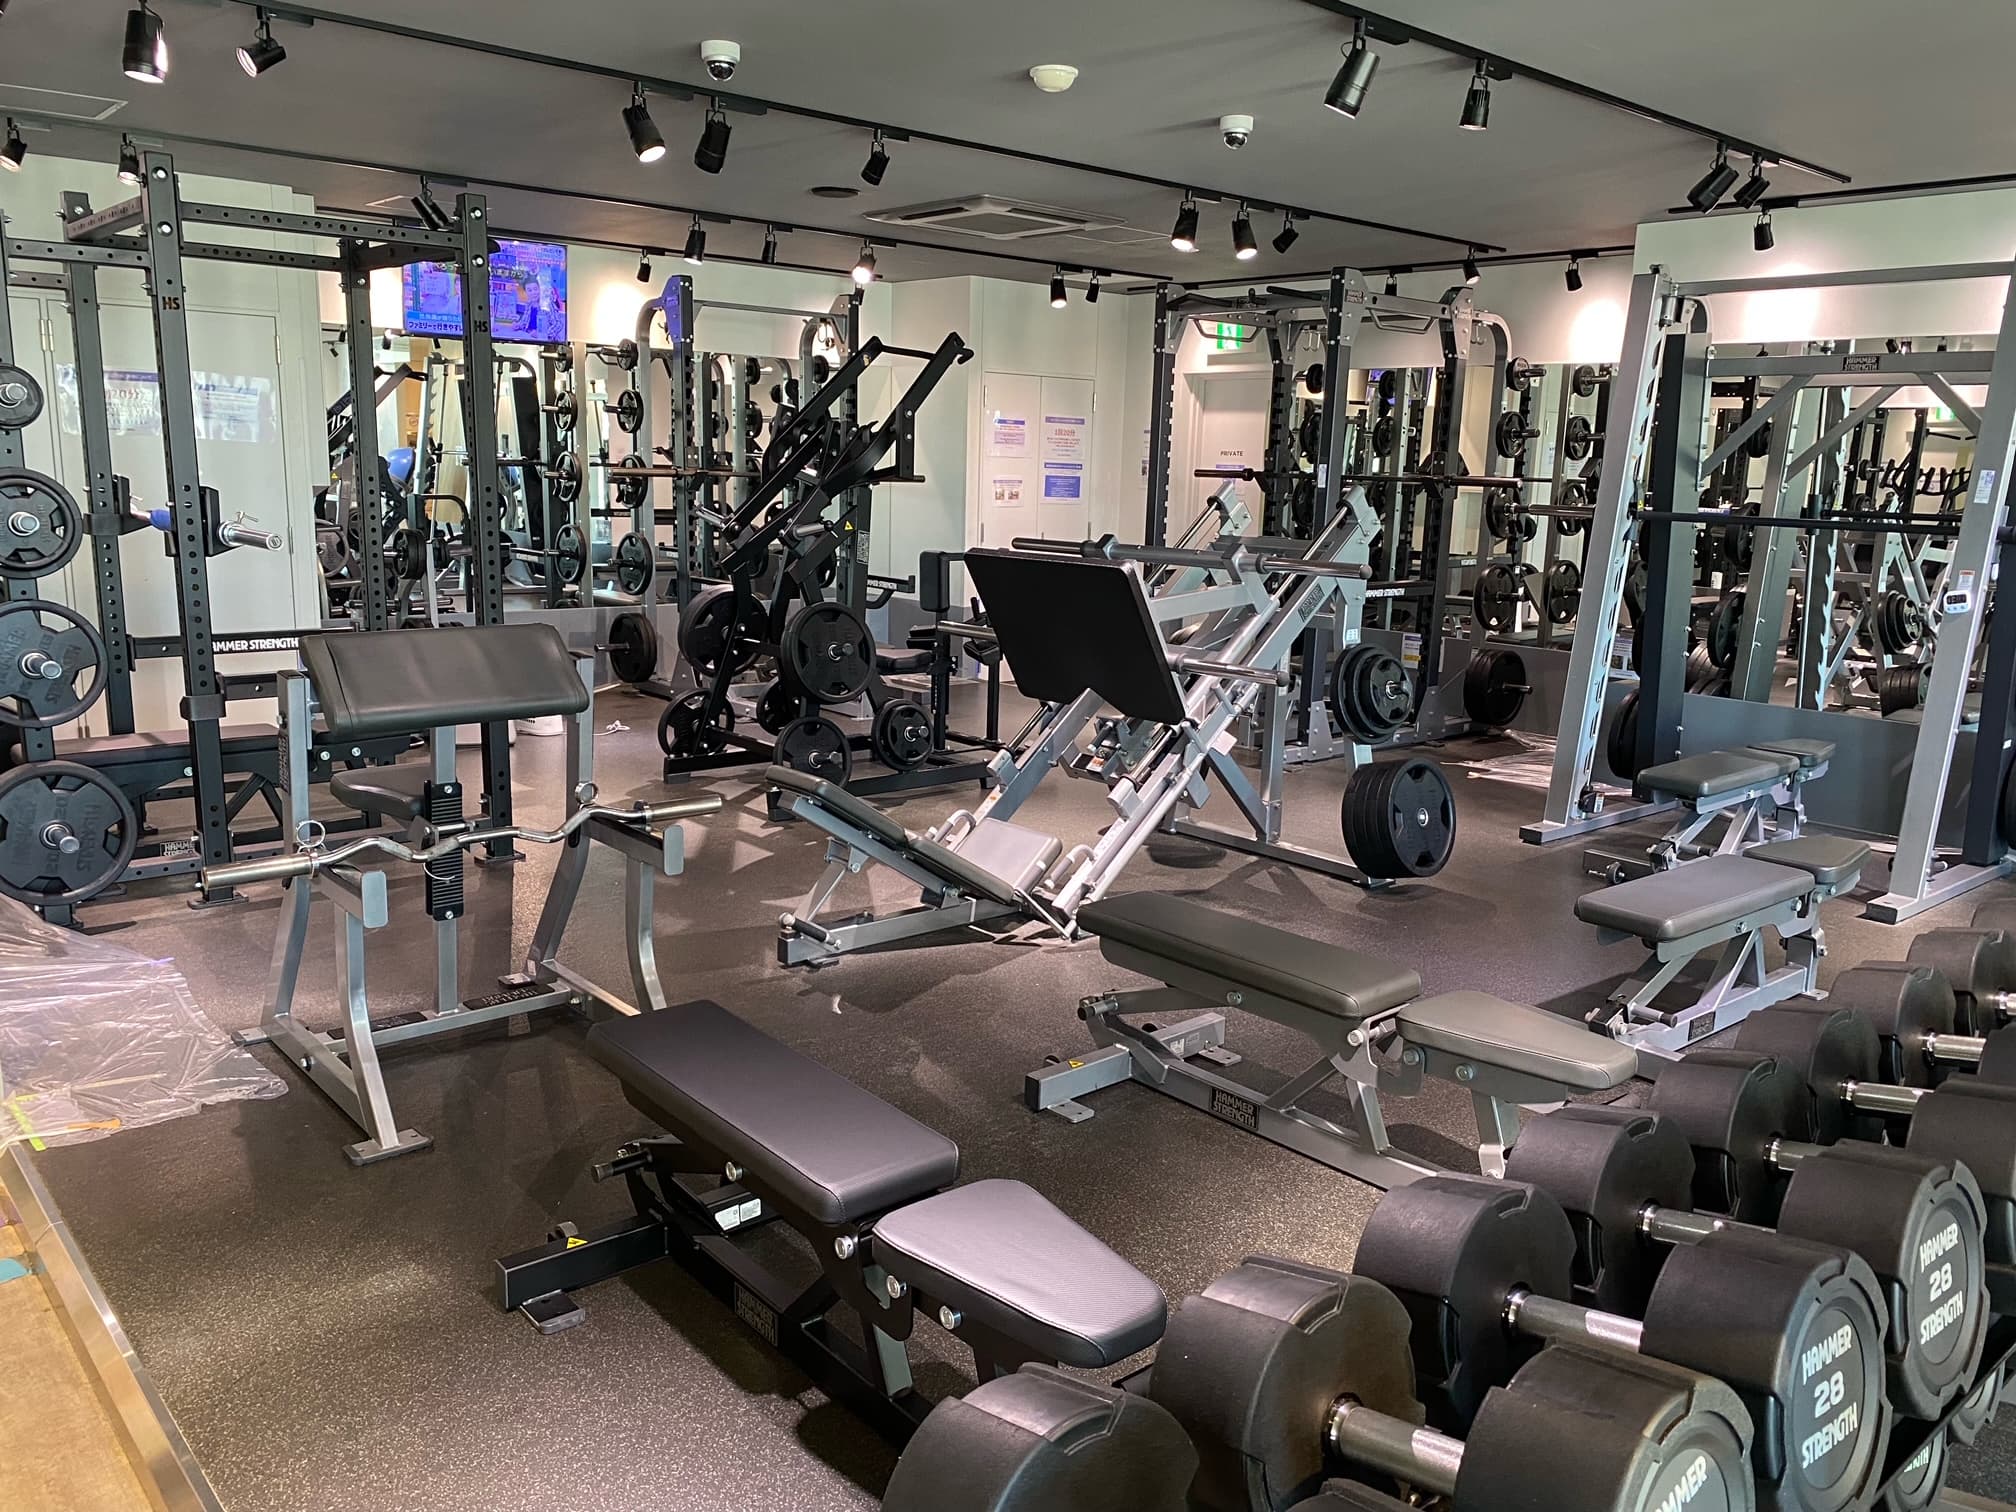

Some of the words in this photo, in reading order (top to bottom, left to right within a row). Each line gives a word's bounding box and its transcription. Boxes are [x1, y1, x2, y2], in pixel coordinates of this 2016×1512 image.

[162, 296, 180, 310] HS
[474, 321, 488, 332] HS
[212, 640, 248, 652] AMMER
[249, 637, 298, 650] STRENGTH
[1213, 1101, 1255, 1127] STRENGTH
[1215, 1090, 1254, 1115] HAMMER
[1920, 1223, 1958, 1273] HAMMER
[1930, 1262, 1953, 1302] 28
[1920, 1291, 1963, 1345] STRENGTH
[1802, 1324, 1852, 1386] HAMMER
[1814, 1370, 1845, 1419] 28
[1802, 1402, 1858, 1470] STRENGTH
[1655, 1456, 1708, 1512] MMER
